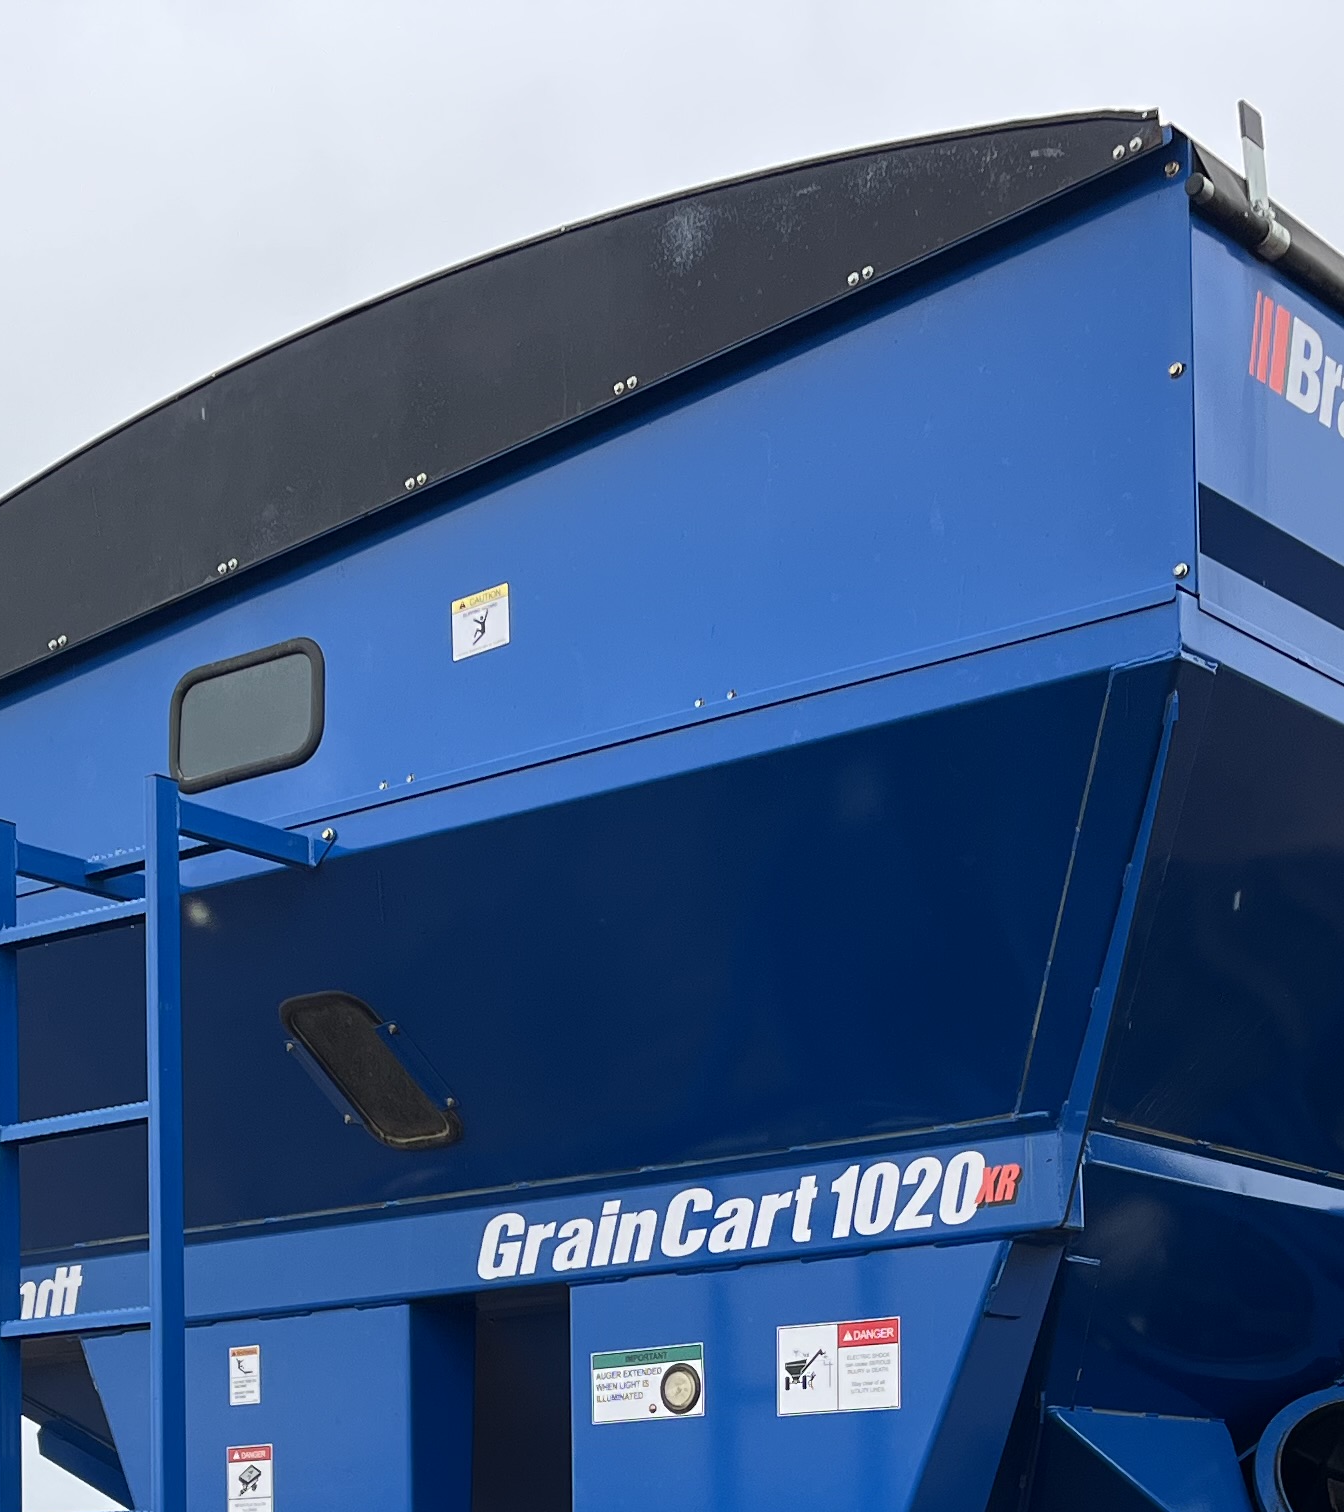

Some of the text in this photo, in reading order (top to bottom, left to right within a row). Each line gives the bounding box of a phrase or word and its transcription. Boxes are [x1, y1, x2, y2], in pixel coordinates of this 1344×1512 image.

[469, 588, 501, 606] CAUTION
[477, 1173, 818, 1281] GrainCart
[853, 1327, 895, 1341] DANGER
[625, 1351, 668, 1363] IMPORTANT
[596, 1367, 663, 1380] AUGER EXTENDED
[596, 1380, 650, 1392] WHEN LIGHT IS
[596, 1391, 644, 1404] ILLUMINATED
[241, 1450, 266, 1460] DANGER
